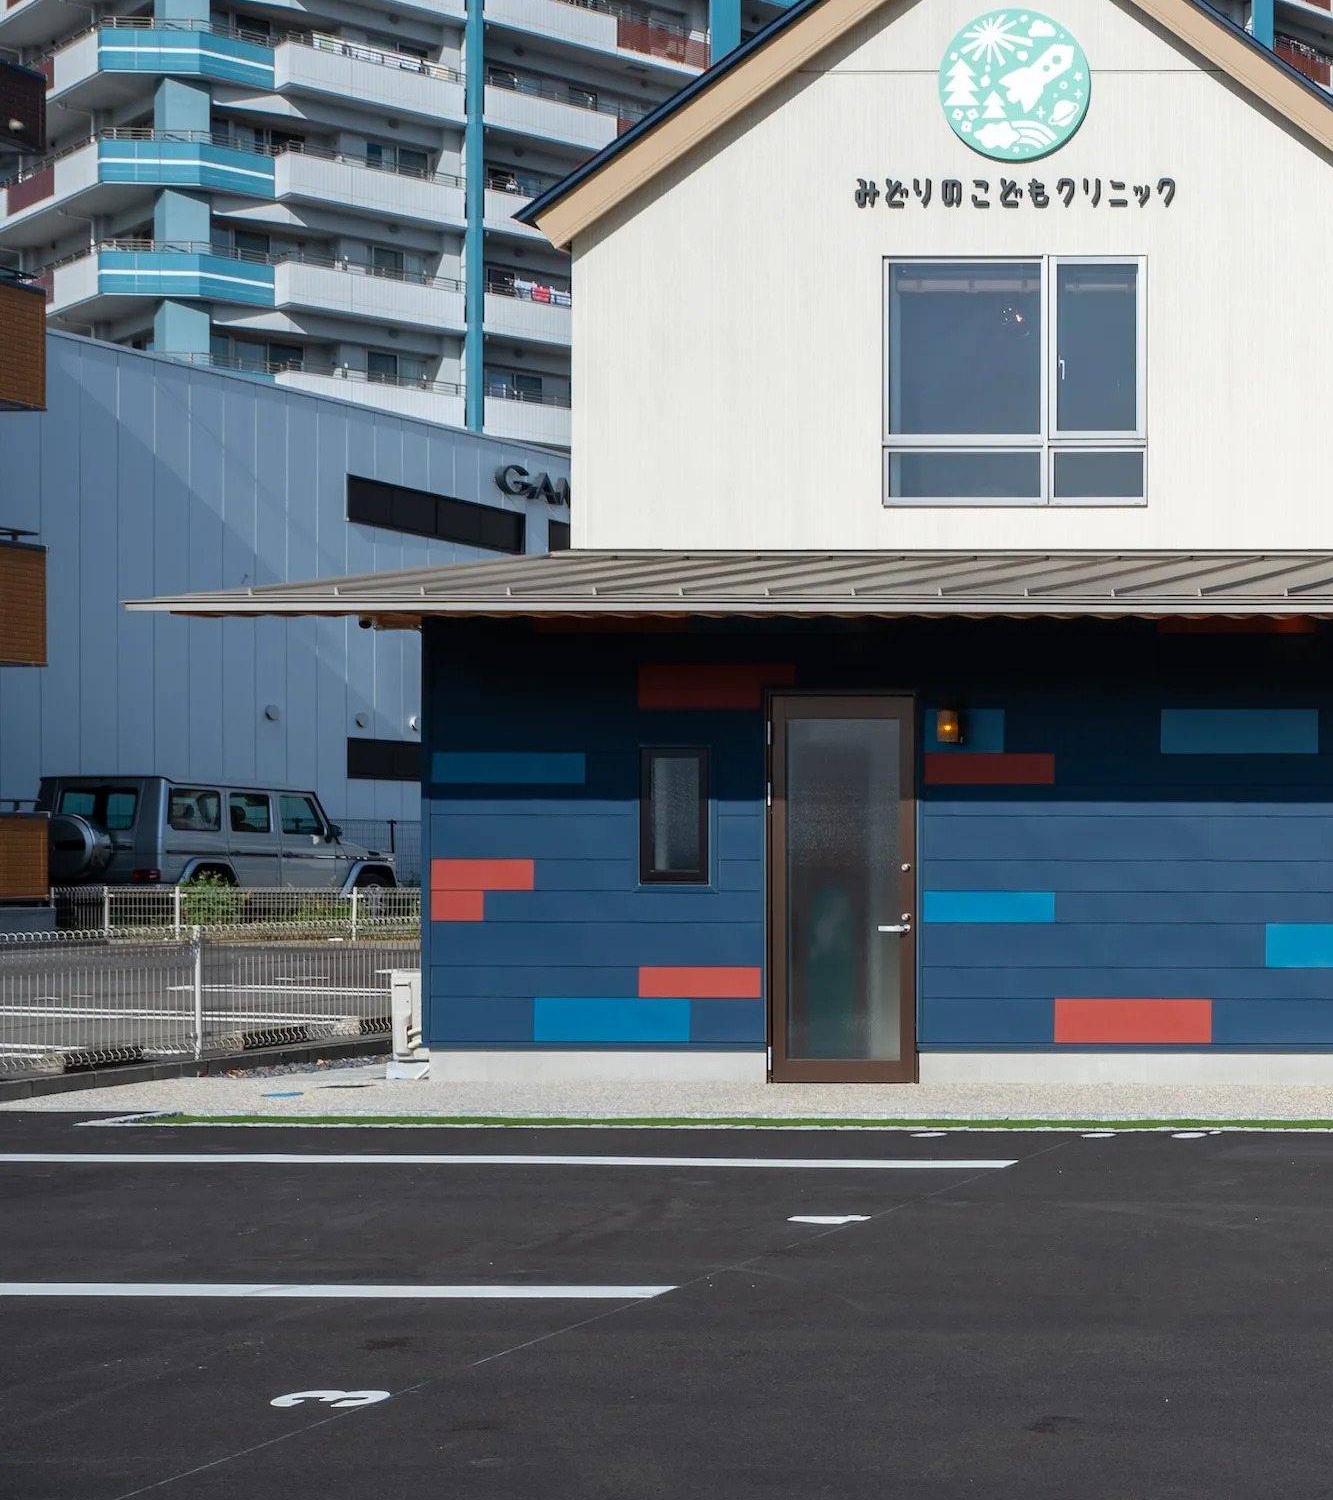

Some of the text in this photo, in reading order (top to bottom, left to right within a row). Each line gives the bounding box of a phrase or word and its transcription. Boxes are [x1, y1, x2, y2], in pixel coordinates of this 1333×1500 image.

[854, 177, 1176, 208] みどりのこどもクリニック
[270, 1389, 391, 1408] 3
